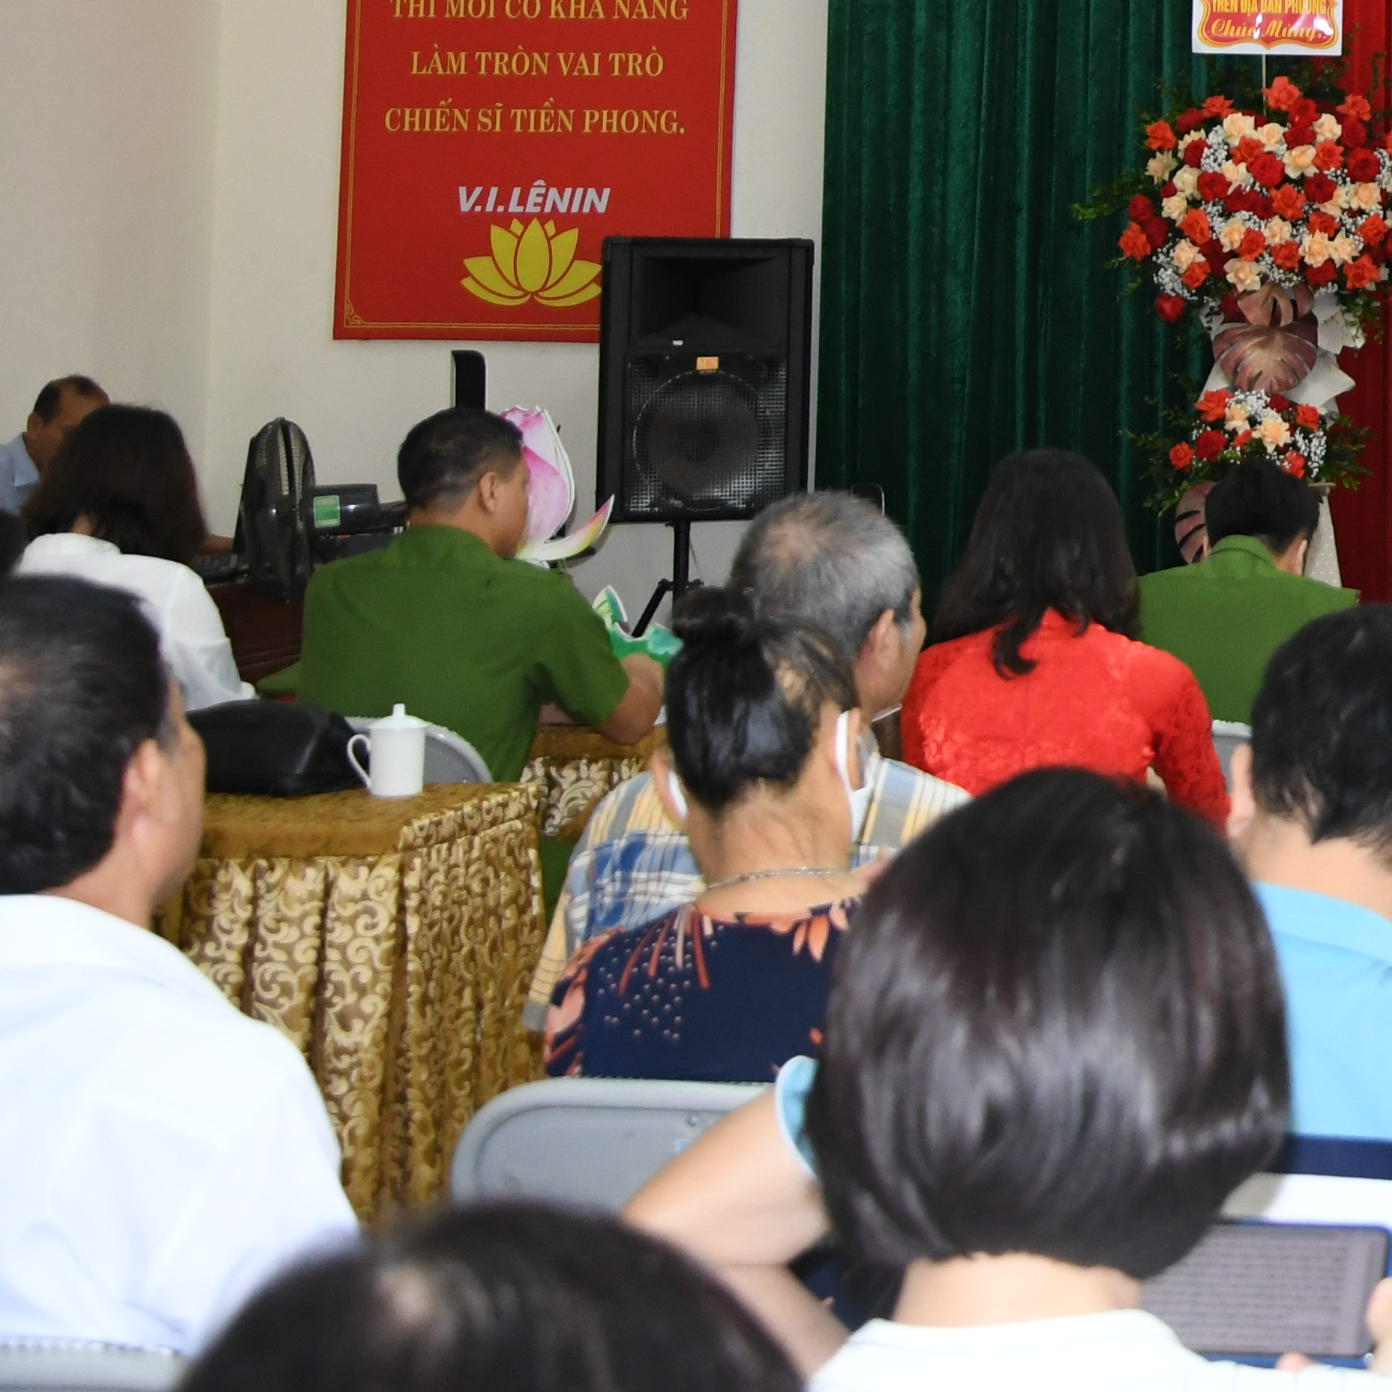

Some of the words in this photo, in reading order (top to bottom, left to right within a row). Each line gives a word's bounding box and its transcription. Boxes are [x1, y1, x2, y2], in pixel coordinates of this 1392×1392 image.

[411, 44, 467, 74] LÀM
[475, 45, 550, 75] TRÒN
[557, 53, 601, 76] VAI
[609, 46, 663, 76] TRÒ
[385, 98, 470, 131] CHIẾN
[477, 103, 503, 132] SĨ
[511, 97, 575, 132] TIỀN
[584, 110, 684, 134] PHONG.
